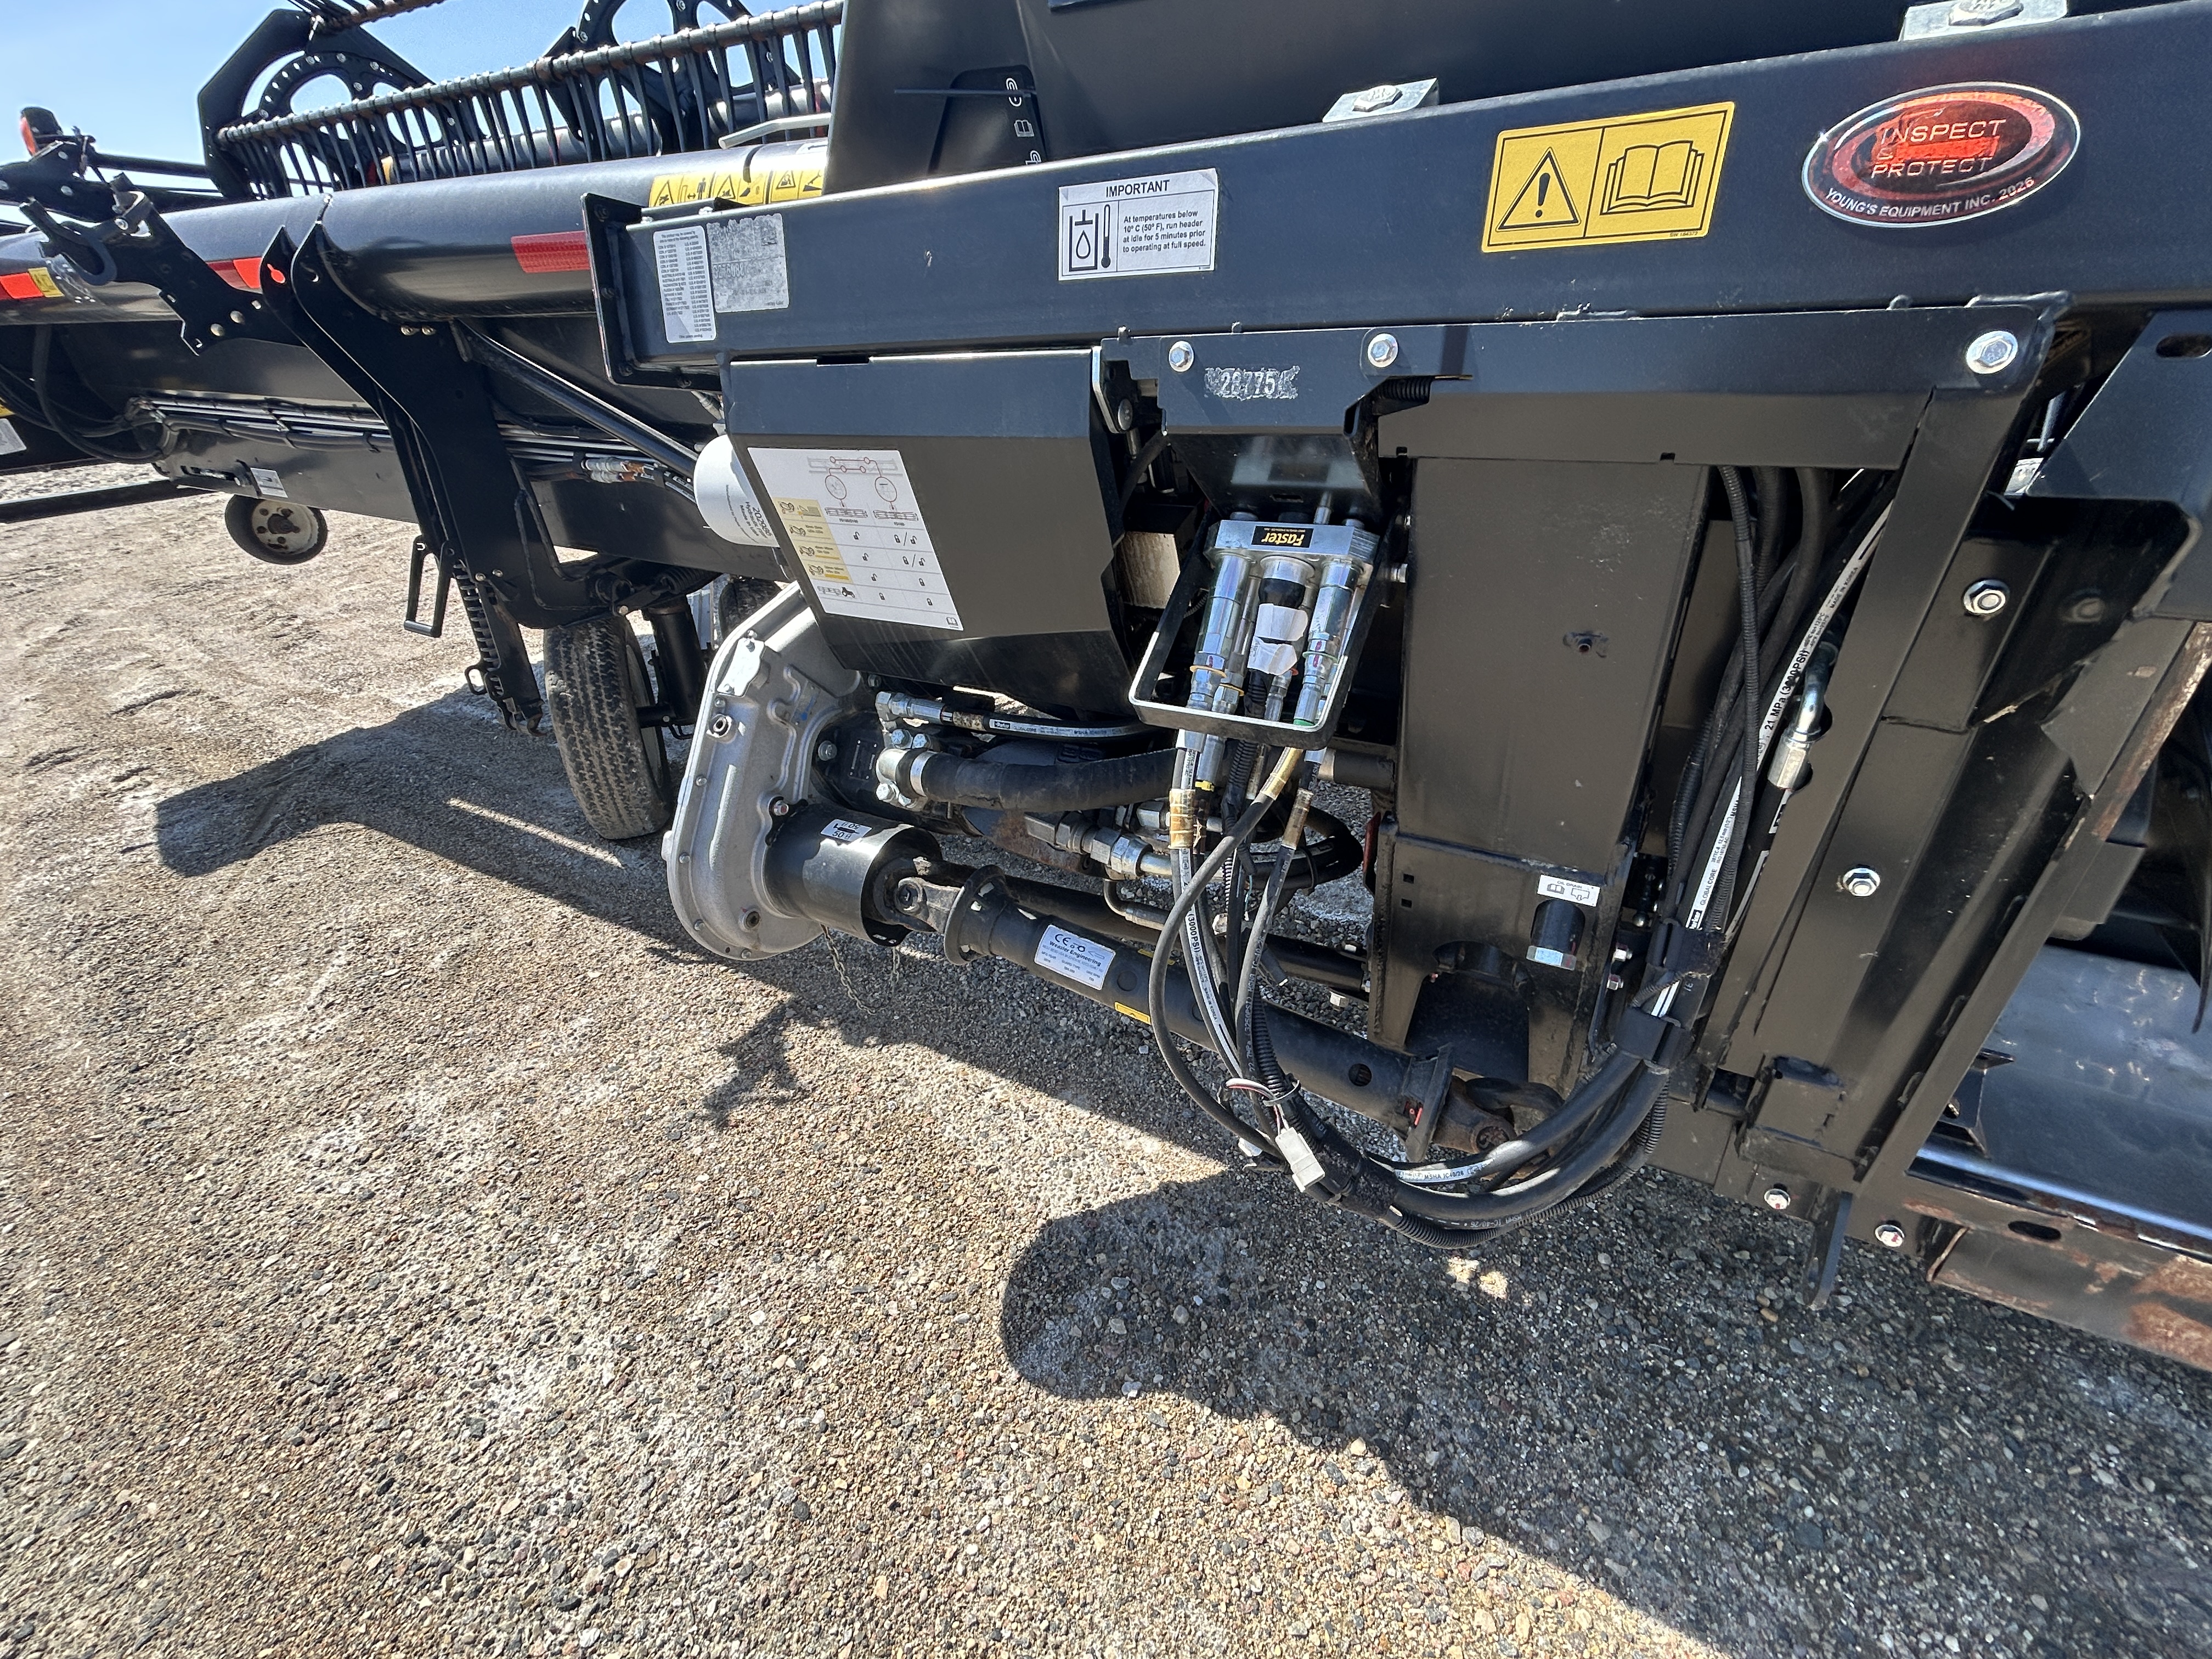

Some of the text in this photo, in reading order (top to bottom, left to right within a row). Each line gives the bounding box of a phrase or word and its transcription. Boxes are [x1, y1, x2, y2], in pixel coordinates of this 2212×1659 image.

[1881, 119, 2006, 144] INSPECT
[1871, 157, 1993, 178] PROTECT
[1106, 179, 1170, 198] IMPORTANT
[1825, 188, 1877, 215] YOUNG'S
[1879, 201, 1961, 217] EQUIPMENT
[1965, 195, 1995, 212] INC.
[1124, 210, 1198, 224] At temperatures below
[1179, 219, 1203, 228] header
[1144, 233, 1153, 241] for
[1160, 231, 1187, 240] minutes
[1189, 229, 1206, 240] prior
[1131, 242, 1161, 254] operating
[1183, 239, 1206, 251] speed.
[1261, 532, 1305, 546] Faster
[1764, 720, 1775, 730] 21
[1770, 697, 1786, 718] MPa
[1689, 911, 1702, 929] arker
[1188, 913, 1201, 953] (3000PSI)
[1049, 940, 1070, 952] Weasler
[1069, 949, 1102, 967] Engineering
